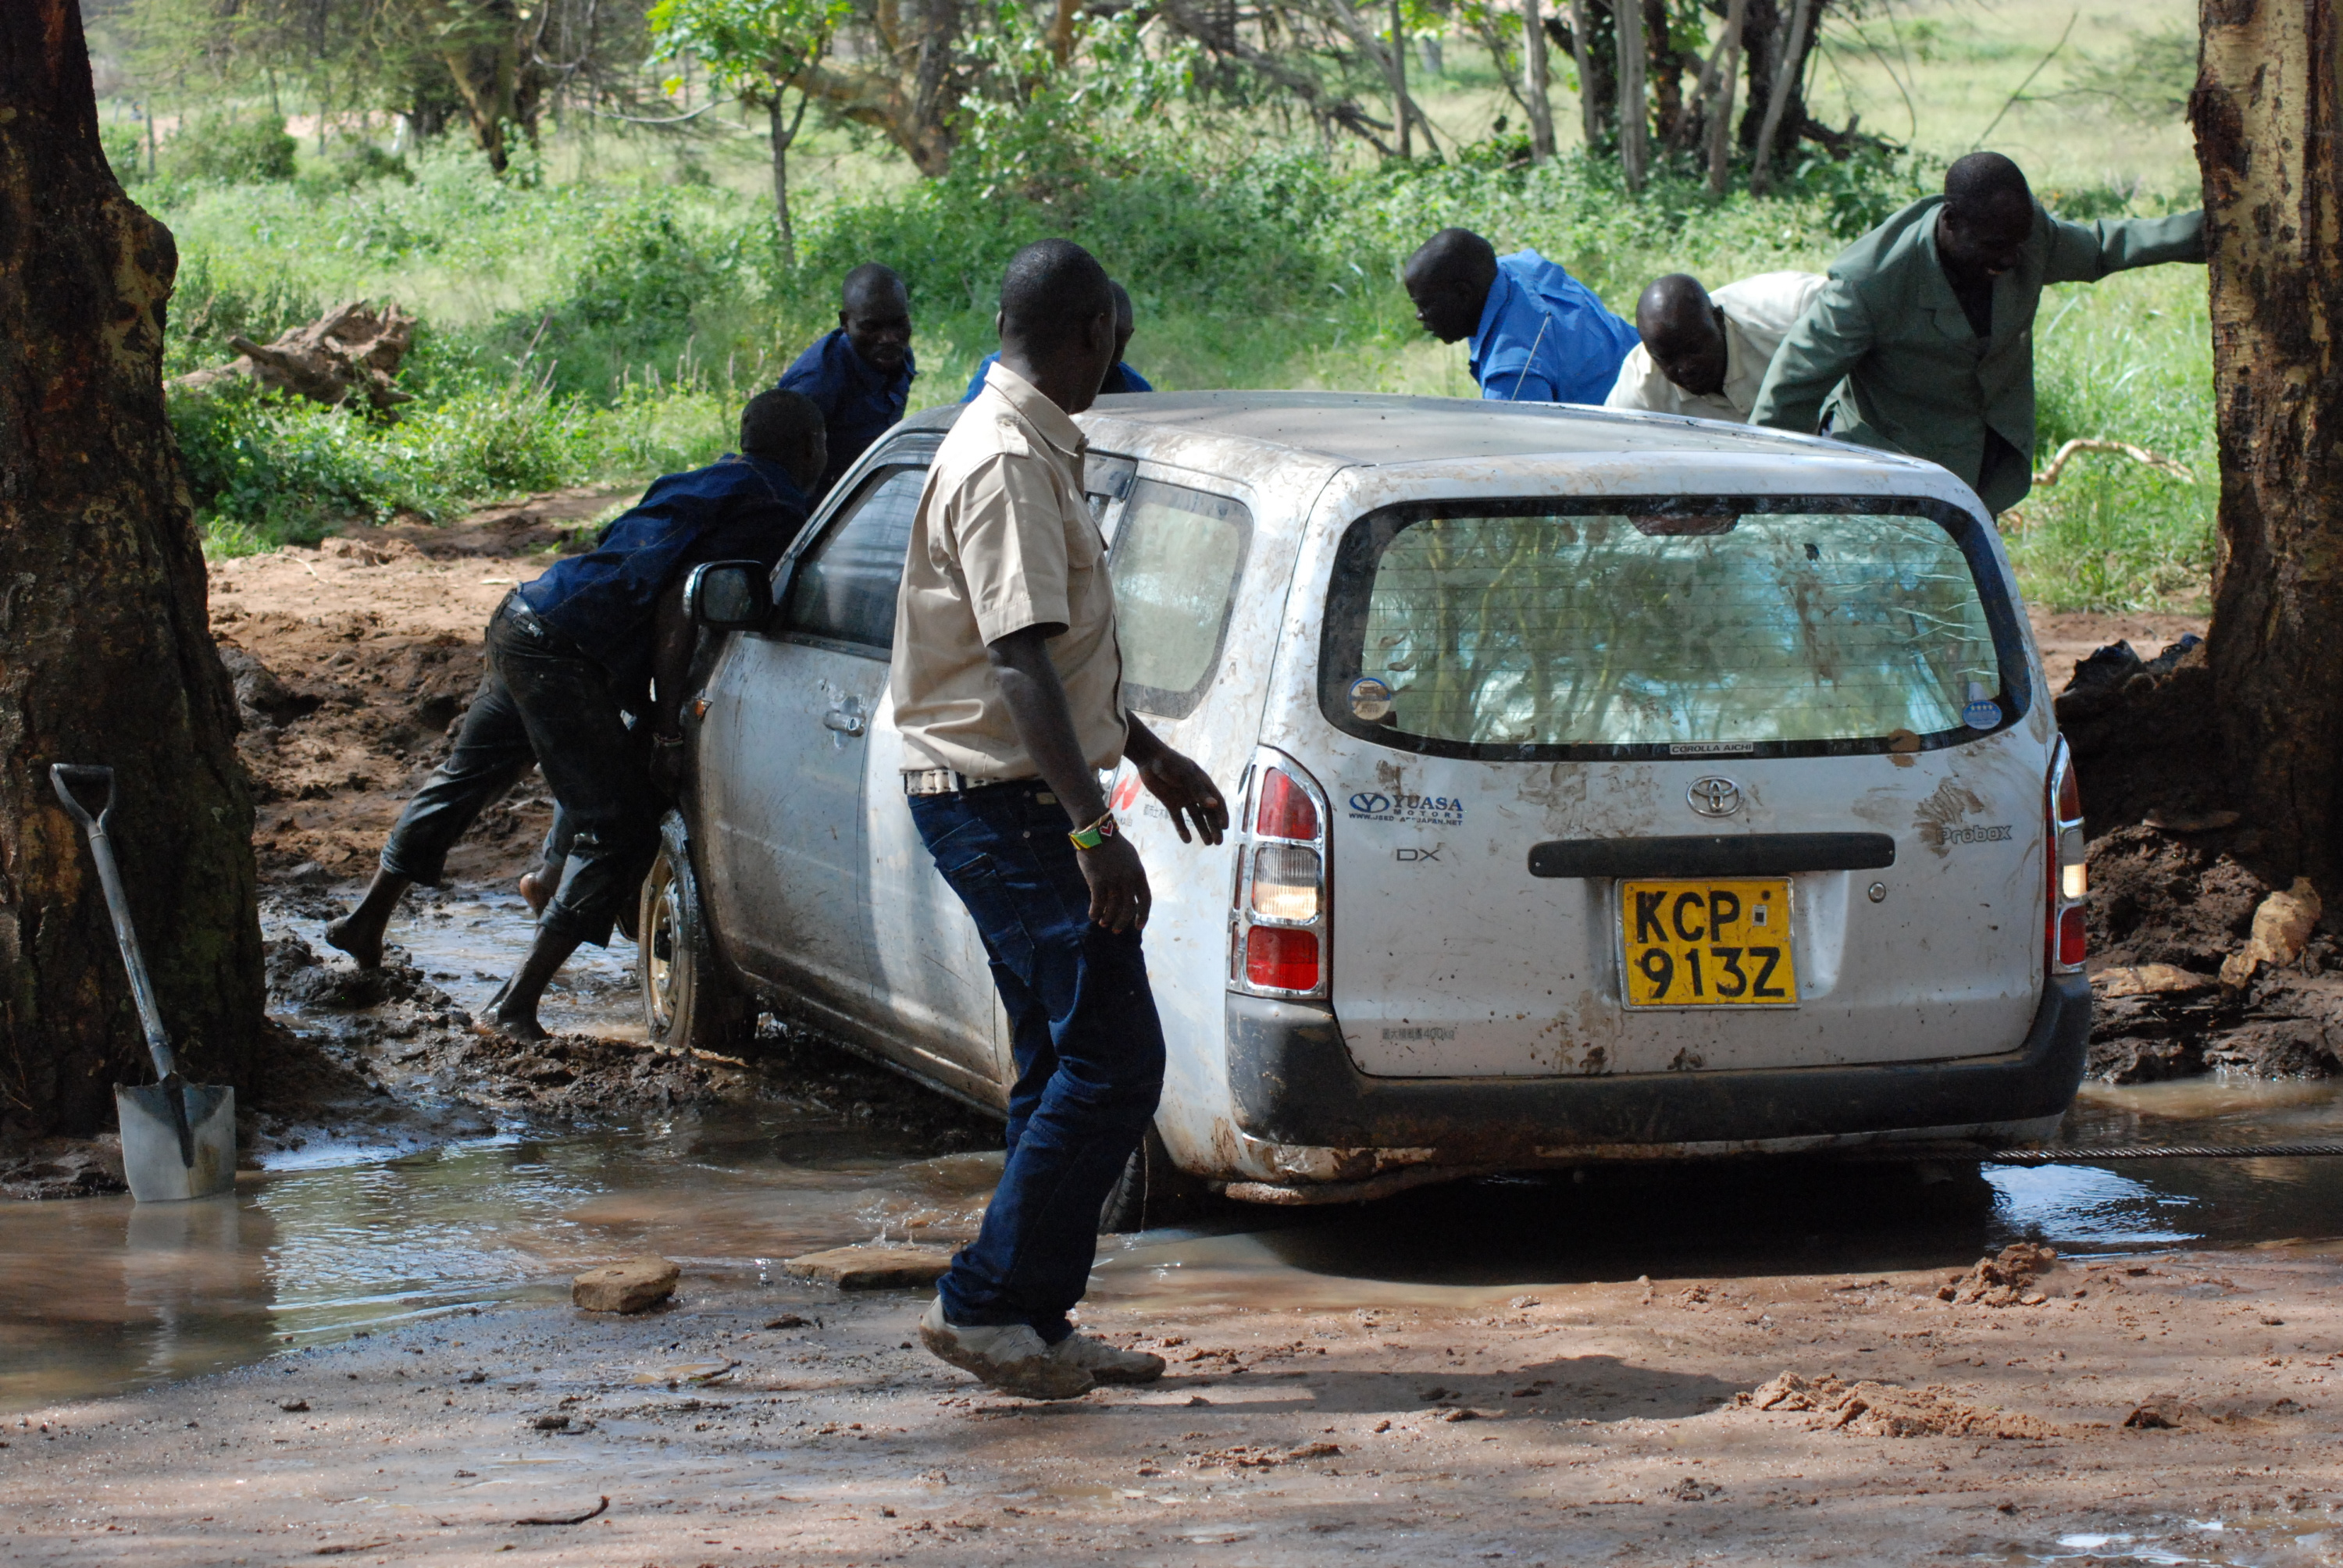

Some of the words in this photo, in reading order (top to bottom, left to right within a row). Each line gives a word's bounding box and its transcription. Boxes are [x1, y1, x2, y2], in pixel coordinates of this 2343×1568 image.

[1671, 744, 1720, 754] COROLLA
[1392, 794, 1464, 812] YUASA
[1393, 809, 1463, 819] MOTORS
[1936, 824, 2013, 844] Probox
[1396, 848, 1441, 861] DX
[1635, 890, 1741, 944] KCP
[1639, 946, 1786, 1000] 913Z
